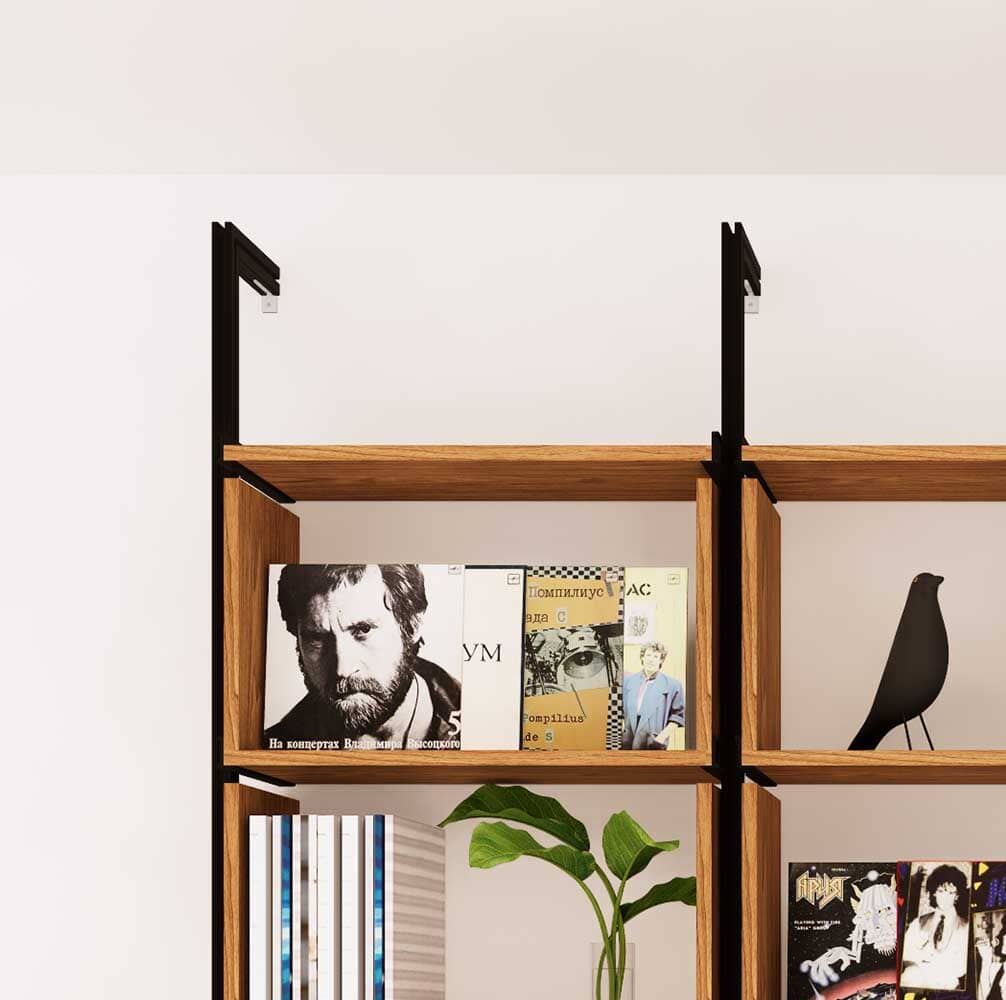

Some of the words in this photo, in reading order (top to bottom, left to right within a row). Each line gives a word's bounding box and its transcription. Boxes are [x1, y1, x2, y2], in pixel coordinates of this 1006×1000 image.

[529, 586, 604, 600] Помпилиус
[626, 583, 651, 596] АС
[463, 643, 501, 662] УМ
[448, 711, 461, 736] 5
[545, 732, 553, 742] S
[269, 738, 283, 749] На
[287, 741, 339, 750] концертах
[344, 738, 402, 750] Владимира
[407, 738, 461, 750] Высоцкого
